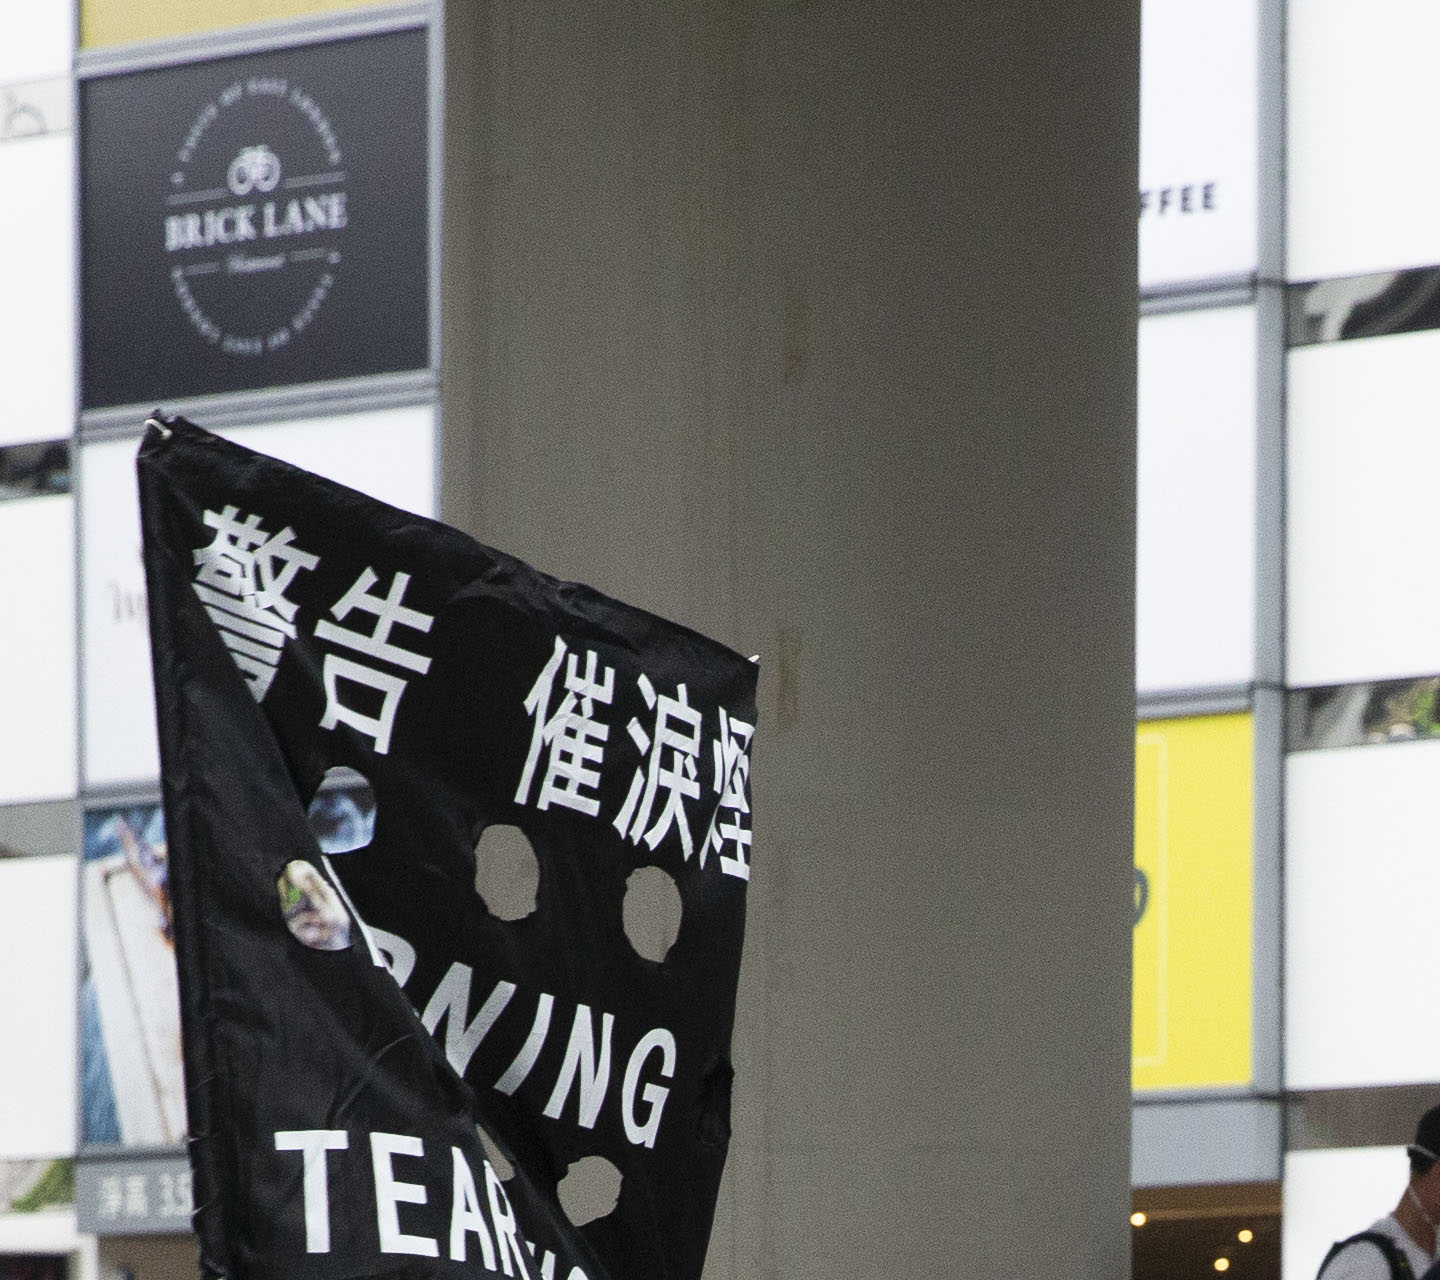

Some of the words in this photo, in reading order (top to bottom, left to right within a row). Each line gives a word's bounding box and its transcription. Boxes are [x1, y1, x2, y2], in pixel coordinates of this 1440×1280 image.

[164, 202, 257, 251] BRICK
[263, 192, 348, 238] LANE
[1138, 181, 1218, 216] FFEE
[191, 504, 436, 755] 警告
